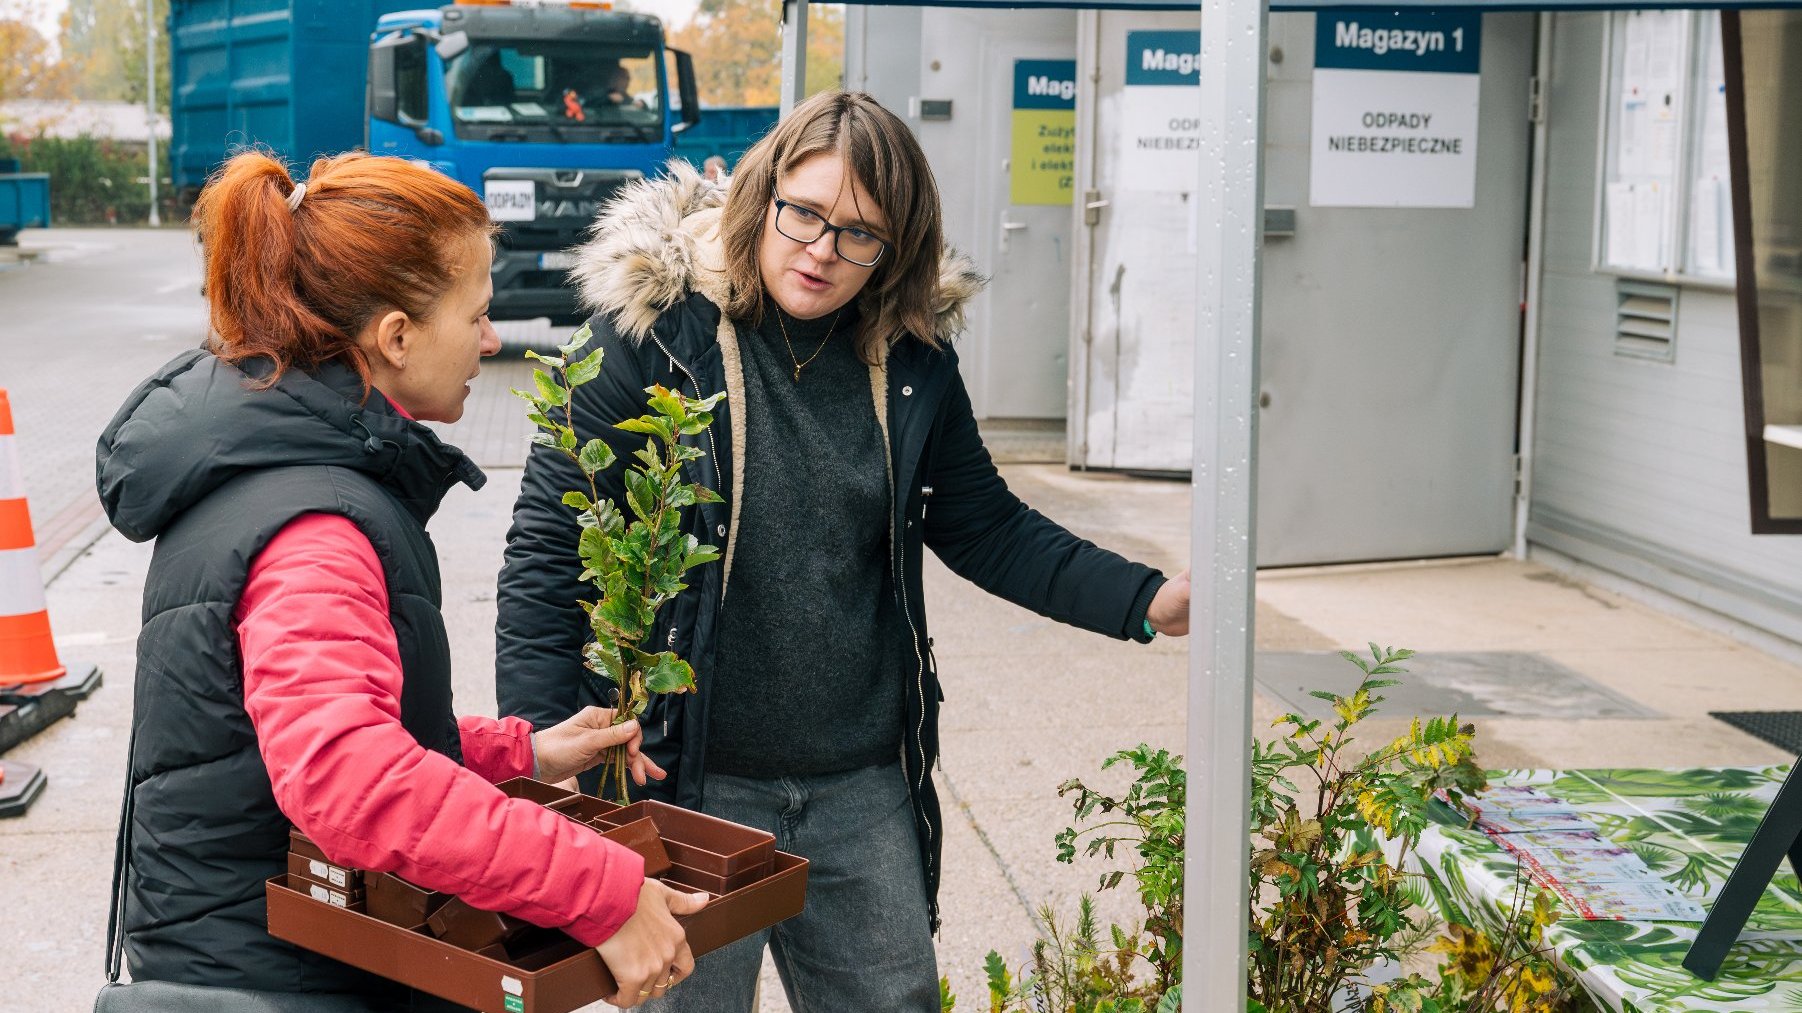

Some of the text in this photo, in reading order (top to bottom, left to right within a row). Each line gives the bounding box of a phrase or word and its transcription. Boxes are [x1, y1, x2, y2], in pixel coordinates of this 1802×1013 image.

[1335, 21, 1464, 56] Magazyn 1
[1027, 75, 1075, 100] Mag
[1362, 112, 1432, 129] ODPADY
[1328, 136, 1463, 154] NIEBEZPIECZNE
